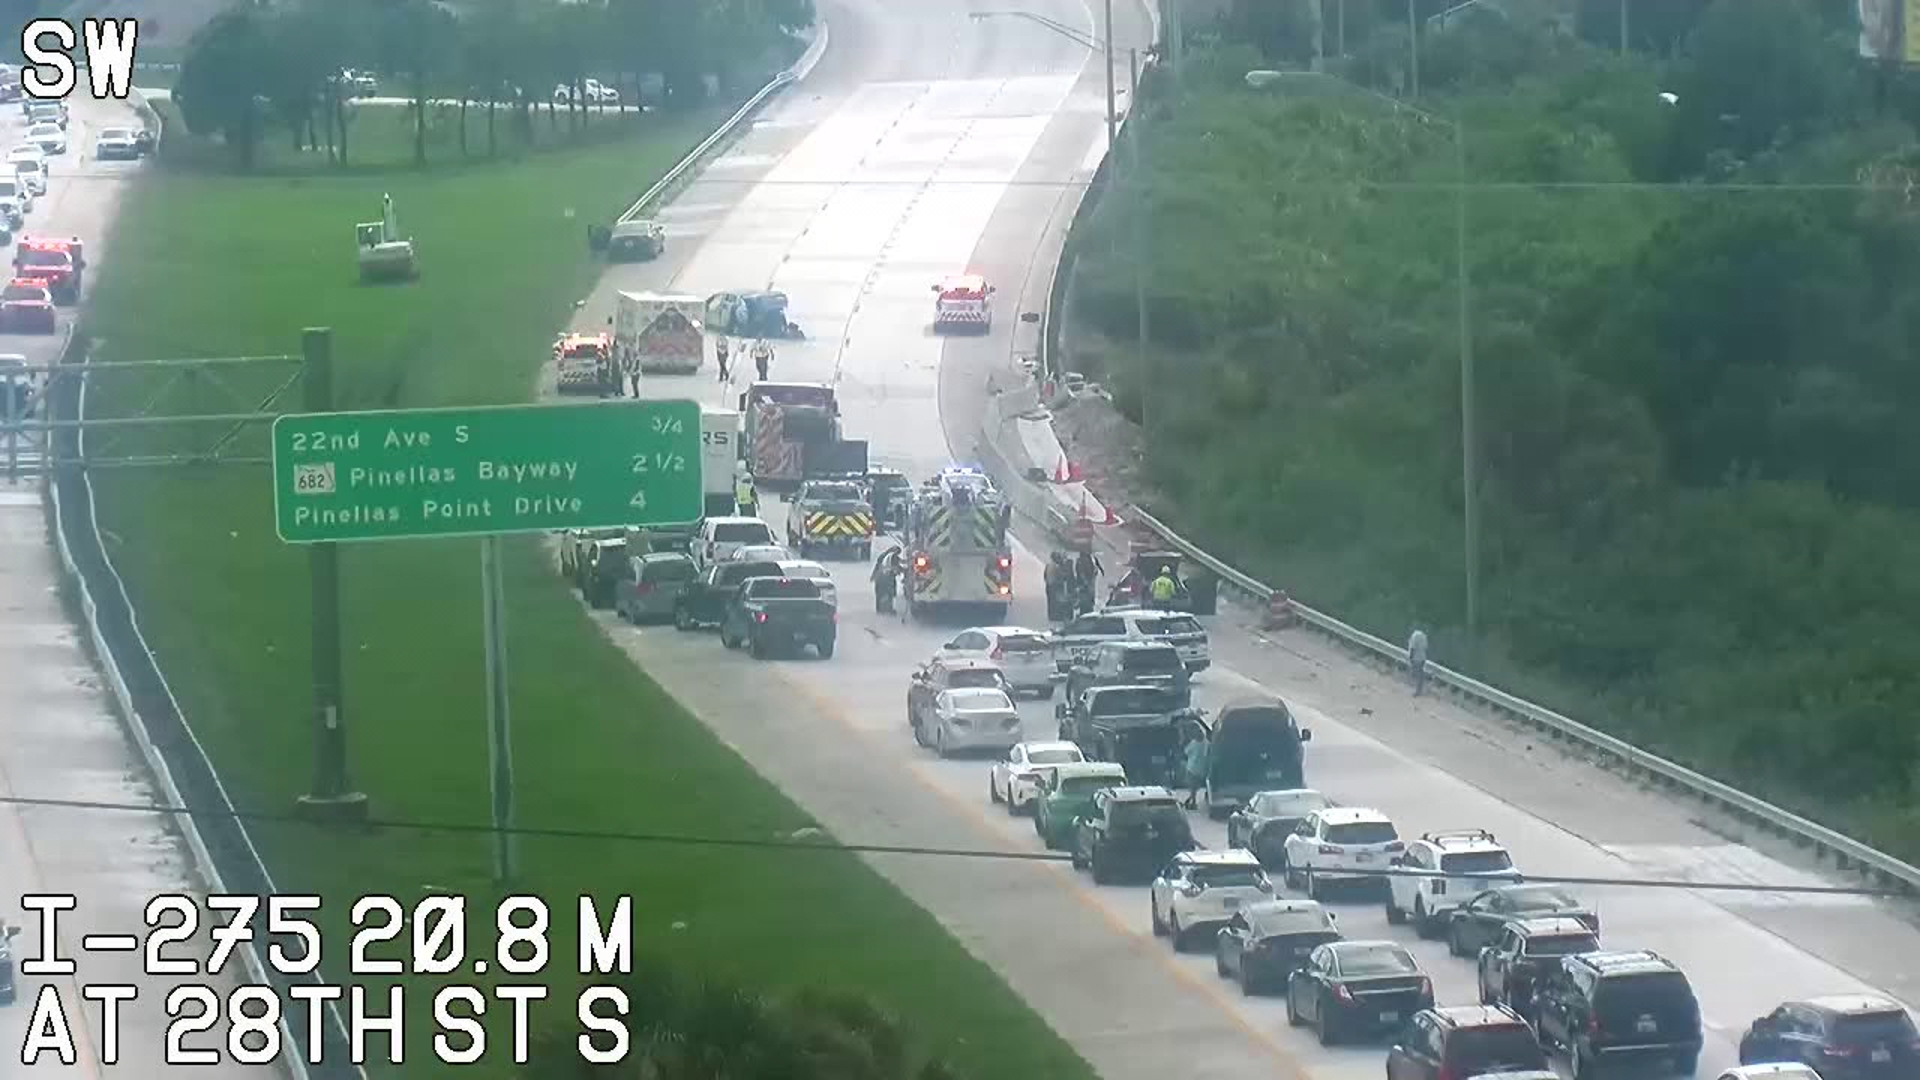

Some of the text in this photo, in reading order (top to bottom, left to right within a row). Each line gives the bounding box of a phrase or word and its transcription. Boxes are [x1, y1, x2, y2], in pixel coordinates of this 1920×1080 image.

[292, 416, 684, 451] 22nd Ave S 3/4
[299, 473, 326, 490] 682
[350, 451, 686, 488] Pinellas Bayway 2 1/2
[295, 491, 647, 526] Pinellas Point Drive 4
